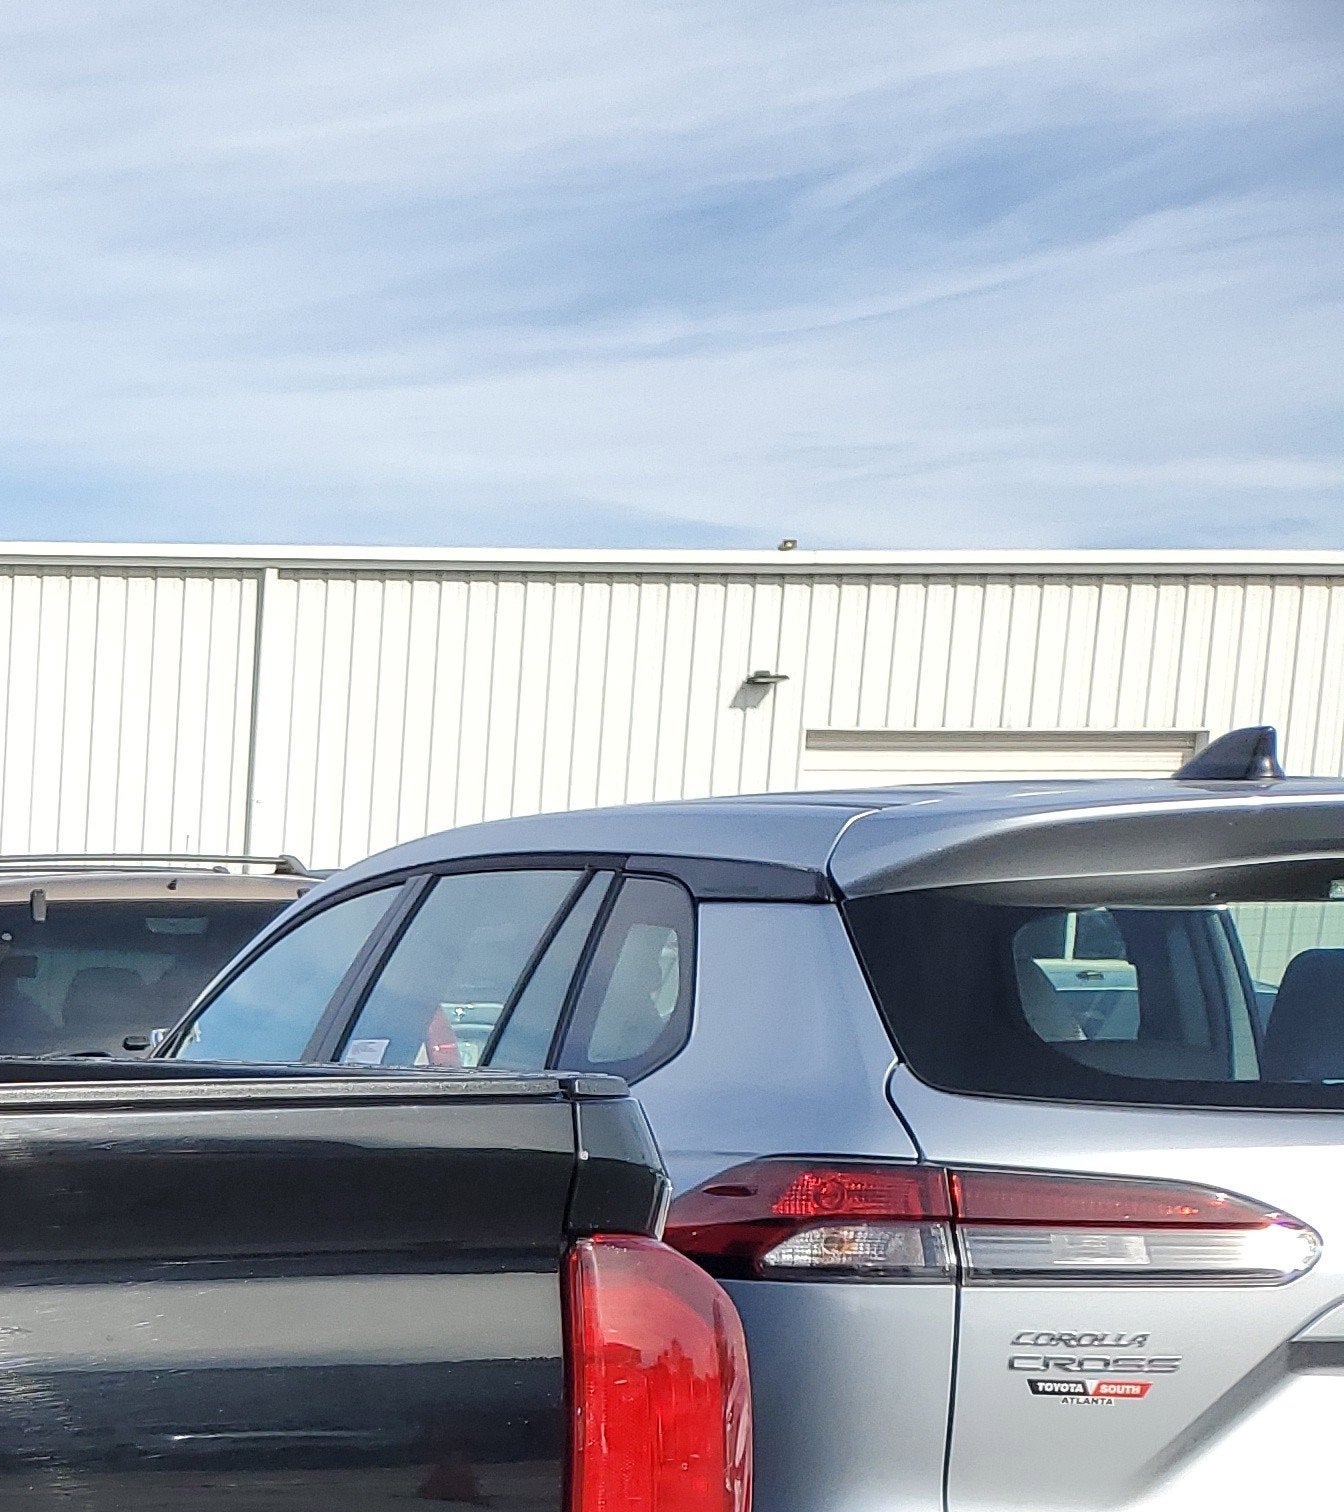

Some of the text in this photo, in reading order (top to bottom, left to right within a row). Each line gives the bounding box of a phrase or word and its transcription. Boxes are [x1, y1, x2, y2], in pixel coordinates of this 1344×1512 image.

[1009, 1330, 1151, 1348] COROLLA
[1008, 1353, 1183, 1373] CROSS
[1035, 1382, 1142, 1396] TOYOTA SOUTH
[1061, 1396, 1114, 1406] ATLANTA
